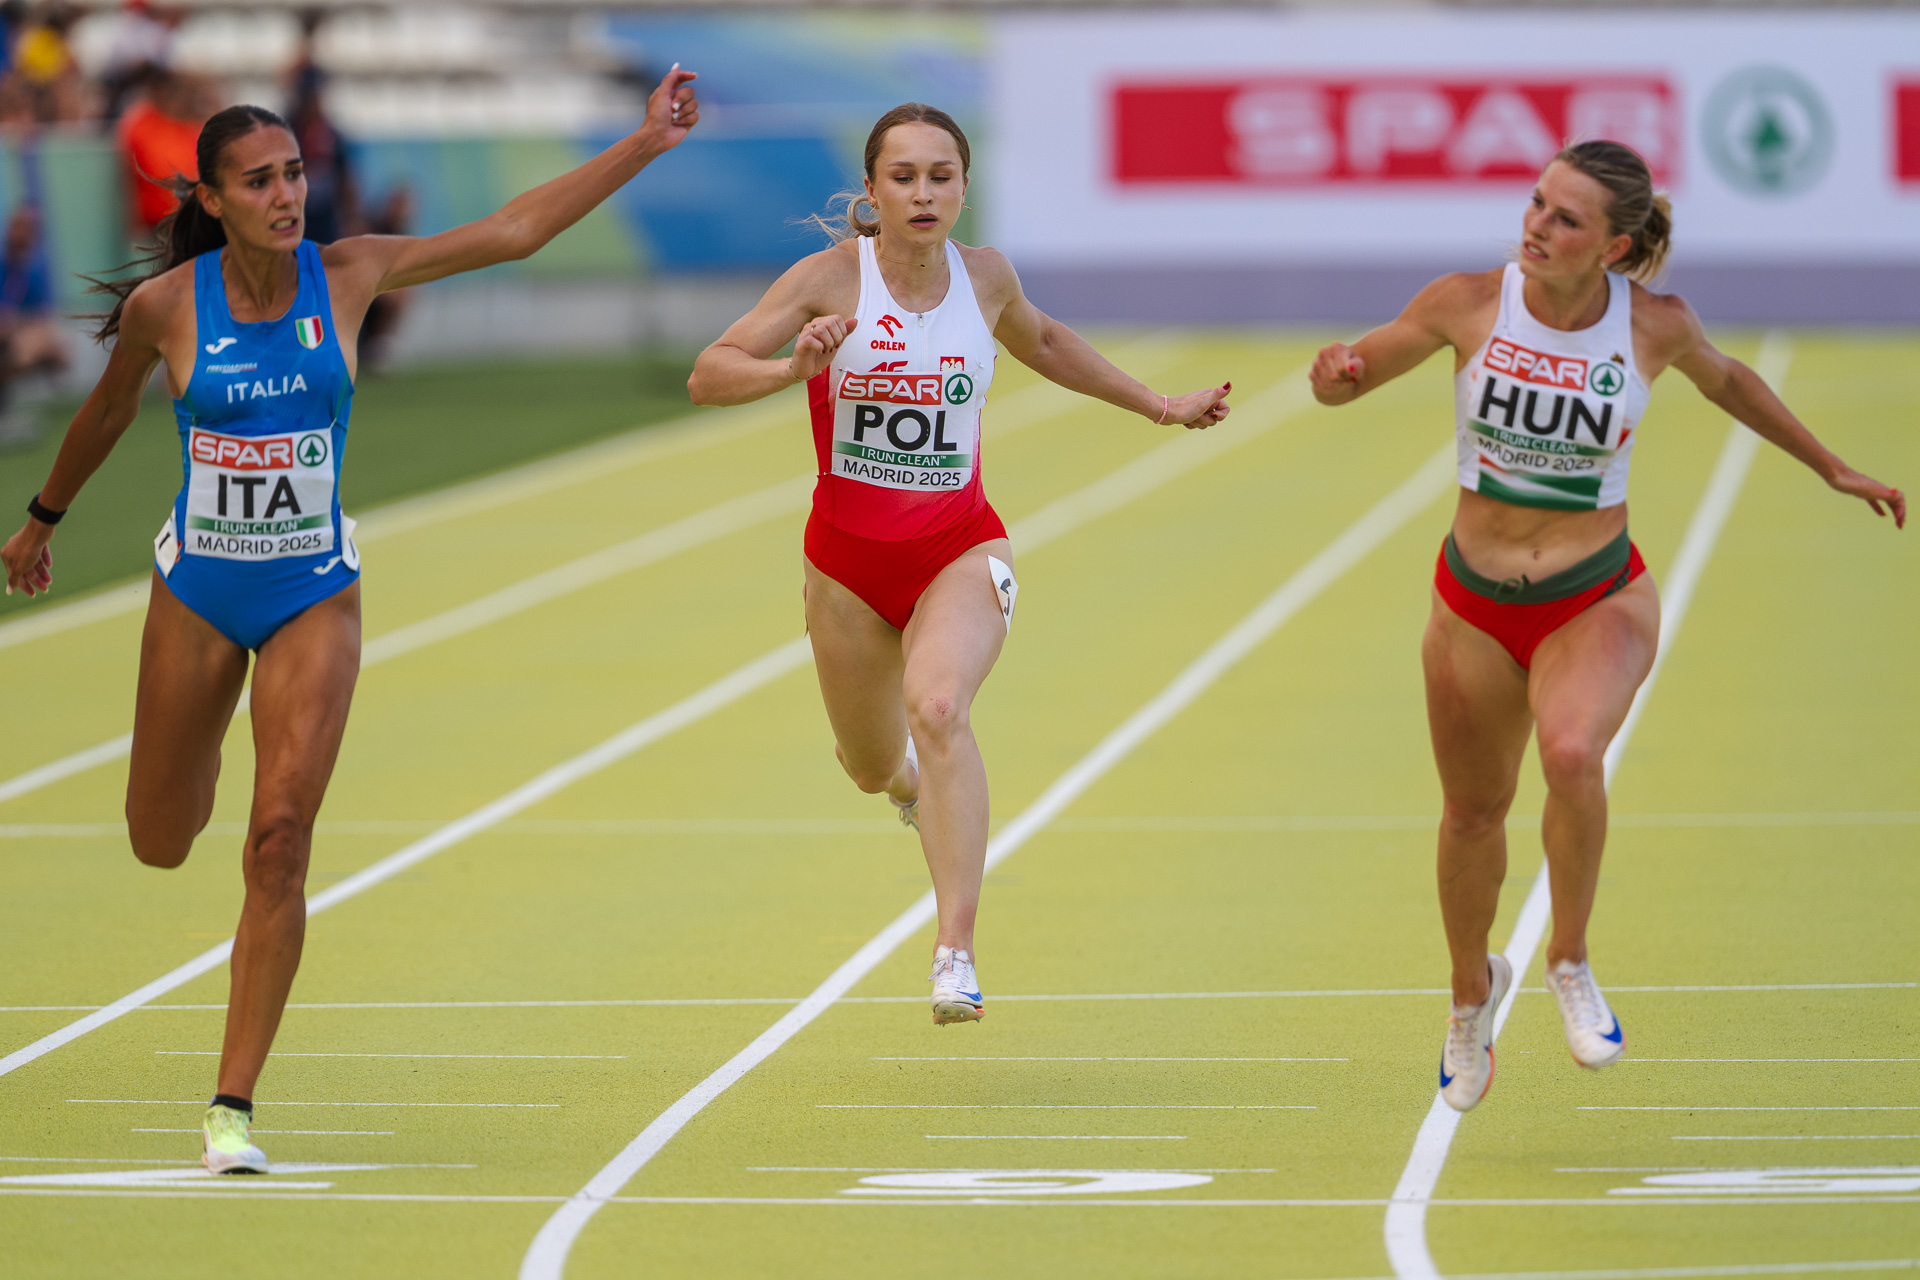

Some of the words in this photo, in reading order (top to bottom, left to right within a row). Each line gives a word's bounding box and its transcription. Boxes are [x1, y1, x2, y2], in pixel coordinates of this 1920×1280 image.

[870, 339, 906, 351] ORLEN
[1486, 341, 1585, 387] SPAR
[226, 373, 307, 403] ITALIA
[842, 378, 940, 401] SPAR
[1478, 375, 1613, 446] HUN
[853, 404, 957, 452] POL
[1500, 431, 1529, 448] RUN
[1531, 439, 1577, 454] CLEAN
[194, 436, 291, 467] SPAR
[861, 447, 866, 457] I
[867, 448, 895, 463] RUN
[1478, 437, 1548, 468] MADRID
[1552, 457, 1595, 472] 2025
[843, 458, 915, 484] MADRID
[919, 472, 961, 486] 2025
[218, 473, 302, 519] ITA
[214, 520, 219, 532] I
[220, 520, 250, 534] RUN
[197, 535, 273, 555] MADRID
[278, 533, 321, 553] 2025
